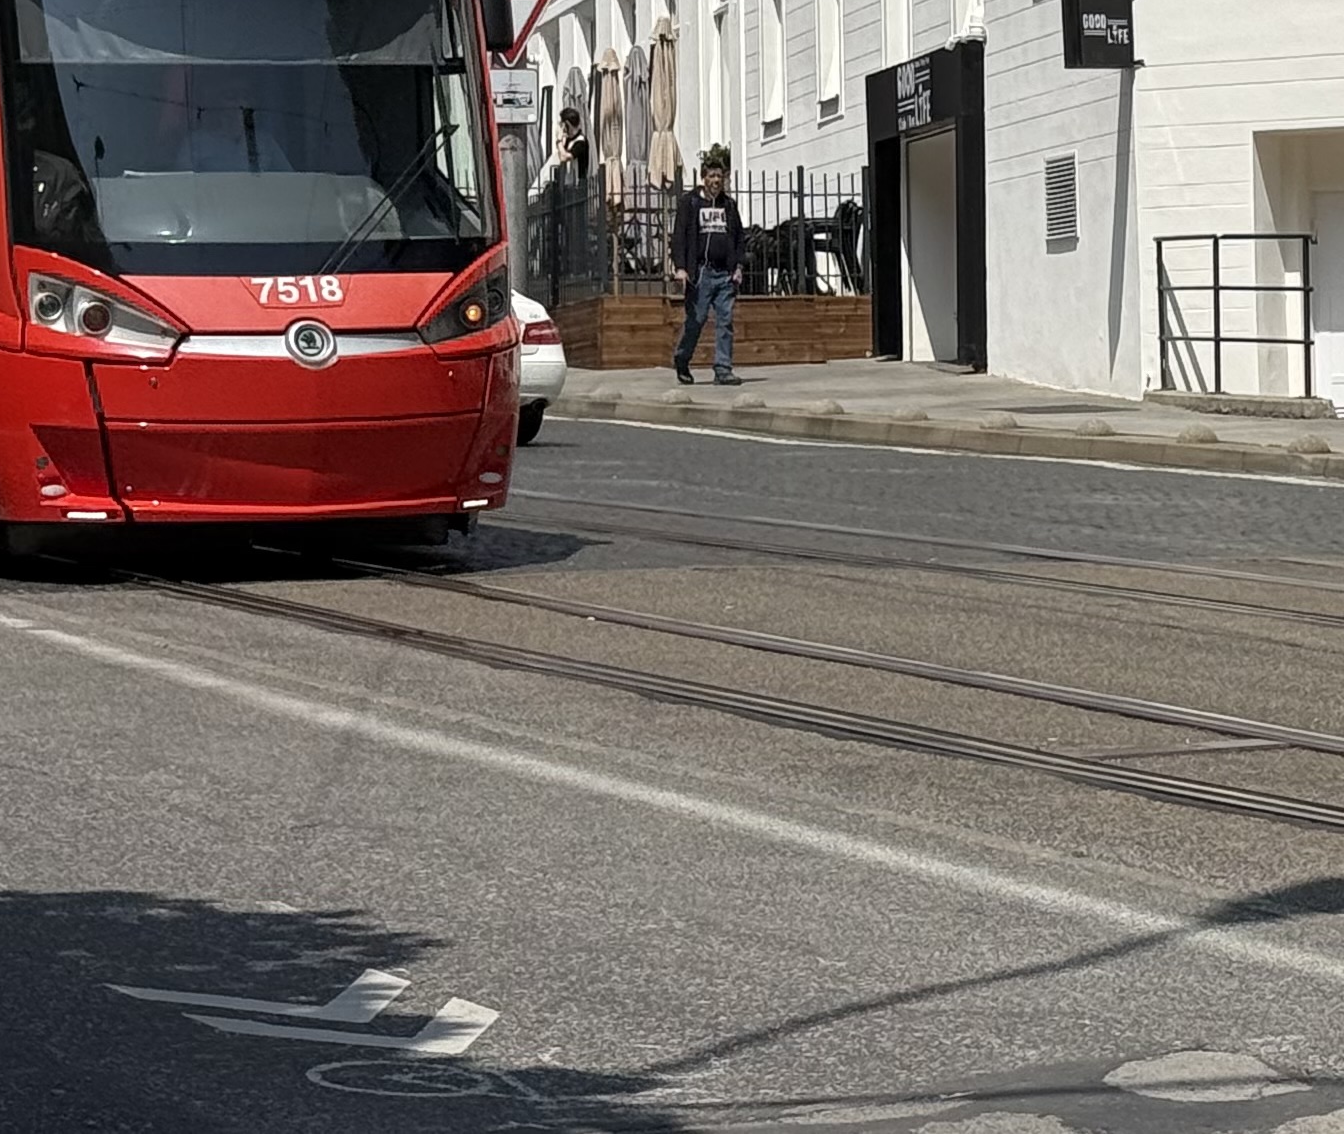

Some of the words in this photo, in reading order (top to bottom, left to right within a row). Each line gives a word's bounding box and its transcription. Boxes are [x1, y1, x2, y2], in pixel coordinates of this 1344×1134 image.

[1082, 13, 1107, 29] GOOD
[1107, 24, 1130, 44] LIFE
[914, 82, 932, 127] LIFE
[250, 275, 344, 304] 7518
